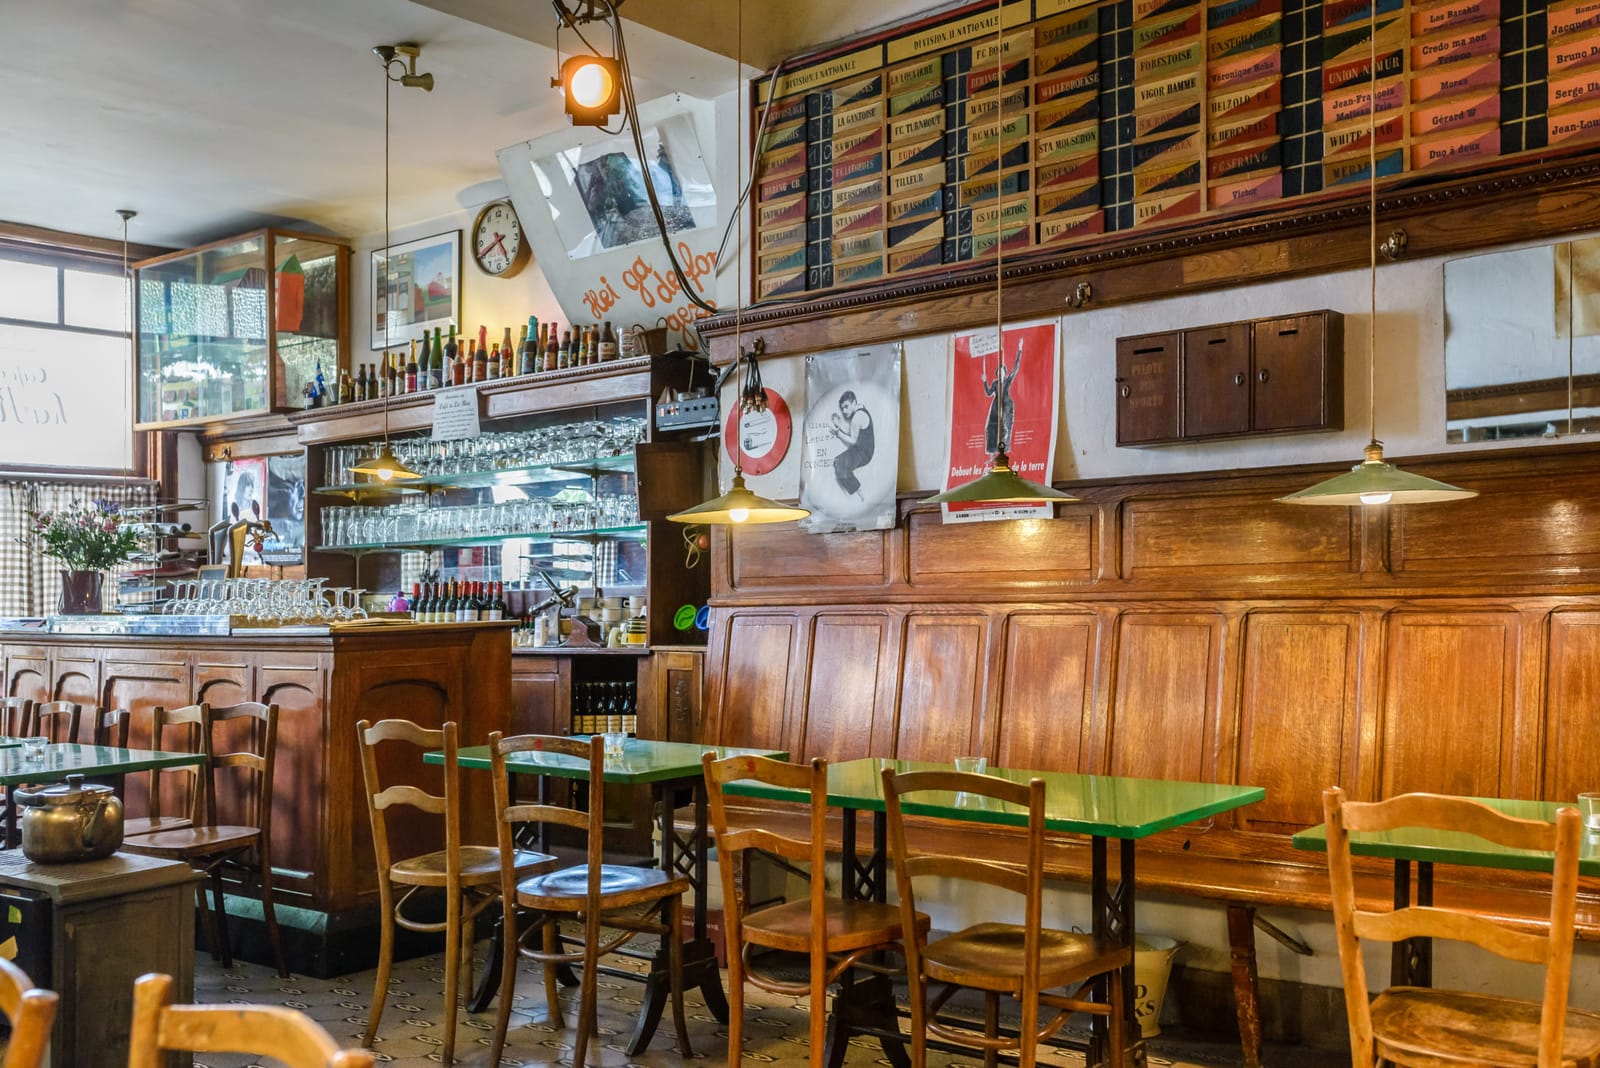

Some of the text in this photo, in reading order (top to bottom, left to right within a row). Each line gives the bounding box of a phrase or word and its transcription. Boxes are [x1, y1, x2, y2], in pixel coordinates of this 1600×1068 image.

[957, 15, 999, 37] NATIONALE
[1551, 19, 1593, 36] Jacques
[976, 48, 986, 60] FC
[1421, 33, 1488, 56] Credo ma non
[1140, 48, 1193, 72] FORESTOISE
[1556, 45, 1600, 65] Bruno D
[820, 61, 855, 79] NATIONALE
[1329, 56, 1400, 85] UNION NMUR
[1041, 72, 1099, 98] WILLEBROEKSE
[1140, 77, 1198, 101] VIGOR HAMME
[1555, 86, 1583, 101] Serge
[837, 107, 875, 127] LA GANTOISE
[894, 114, 941, 137] FC TURNHOUT
[972, 121, 1016, 142] RC MALNES
[1329, 130, 1362, 148] WHITE
[1055, 132, 1097, 152] MOUSCRON
[1429, 148, 1447, 161] Duo
[895, 172, 924, 189] TILLEUR
[1139, 202, 1164, 218] LYRA
[951, 465, 973, 477] Debout
[1021, 459, 1028, 472] la
[1028, 461, 1045, 472] terre
